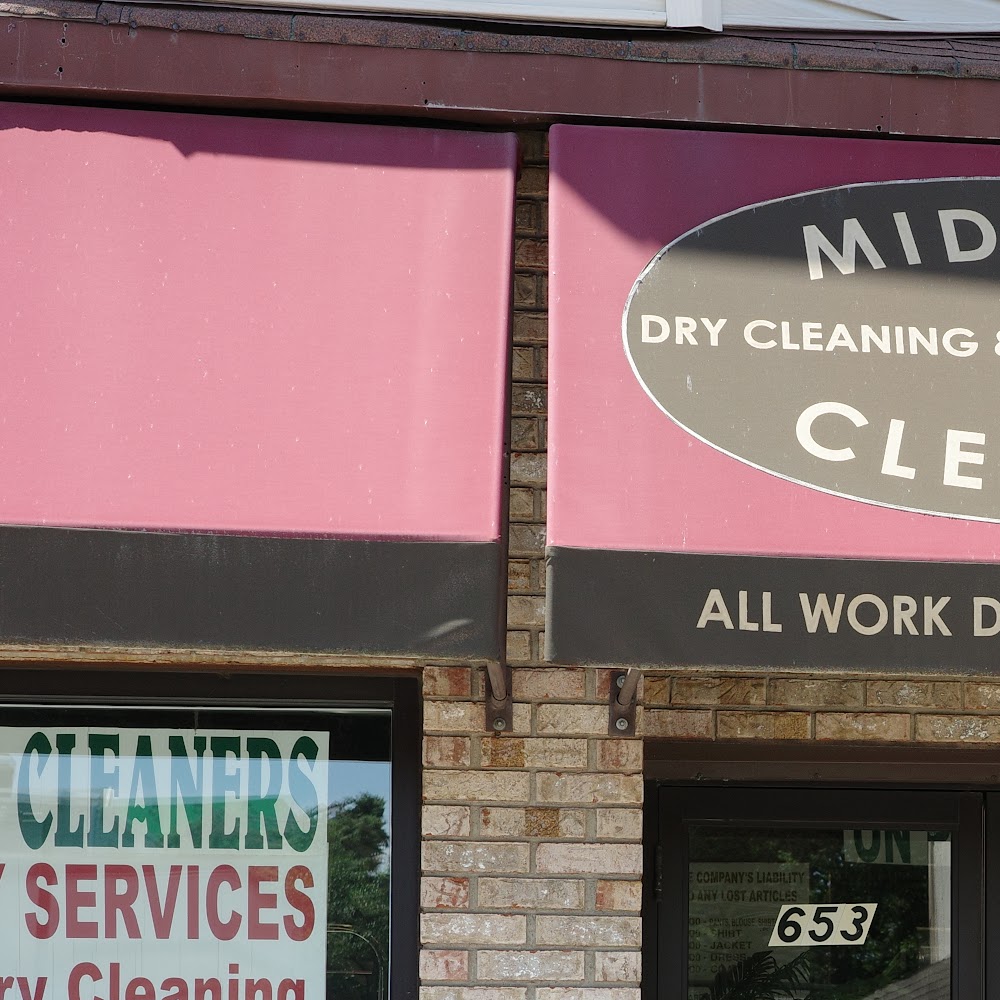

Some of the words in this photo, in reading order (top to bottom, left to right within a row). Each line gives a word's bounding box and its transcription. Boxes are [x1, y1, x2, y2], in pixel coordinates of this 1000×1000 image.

[640, 314, 728, 347] DRY
[743, 319, 979, 358] CLEANING
[696, 588, 783, 633] ALL
[798, 593, 953, 637] WORK
[17, 731, 320, 853] CLEANERS
[749, 889, 798, 901] ARTICLES
[756, 871, 805, 884] LIABILITY
[24, 862, 316, 942] SERVICES
[777, 905, 869, 943] 653
[710, 941, 753, 950] JACKET
